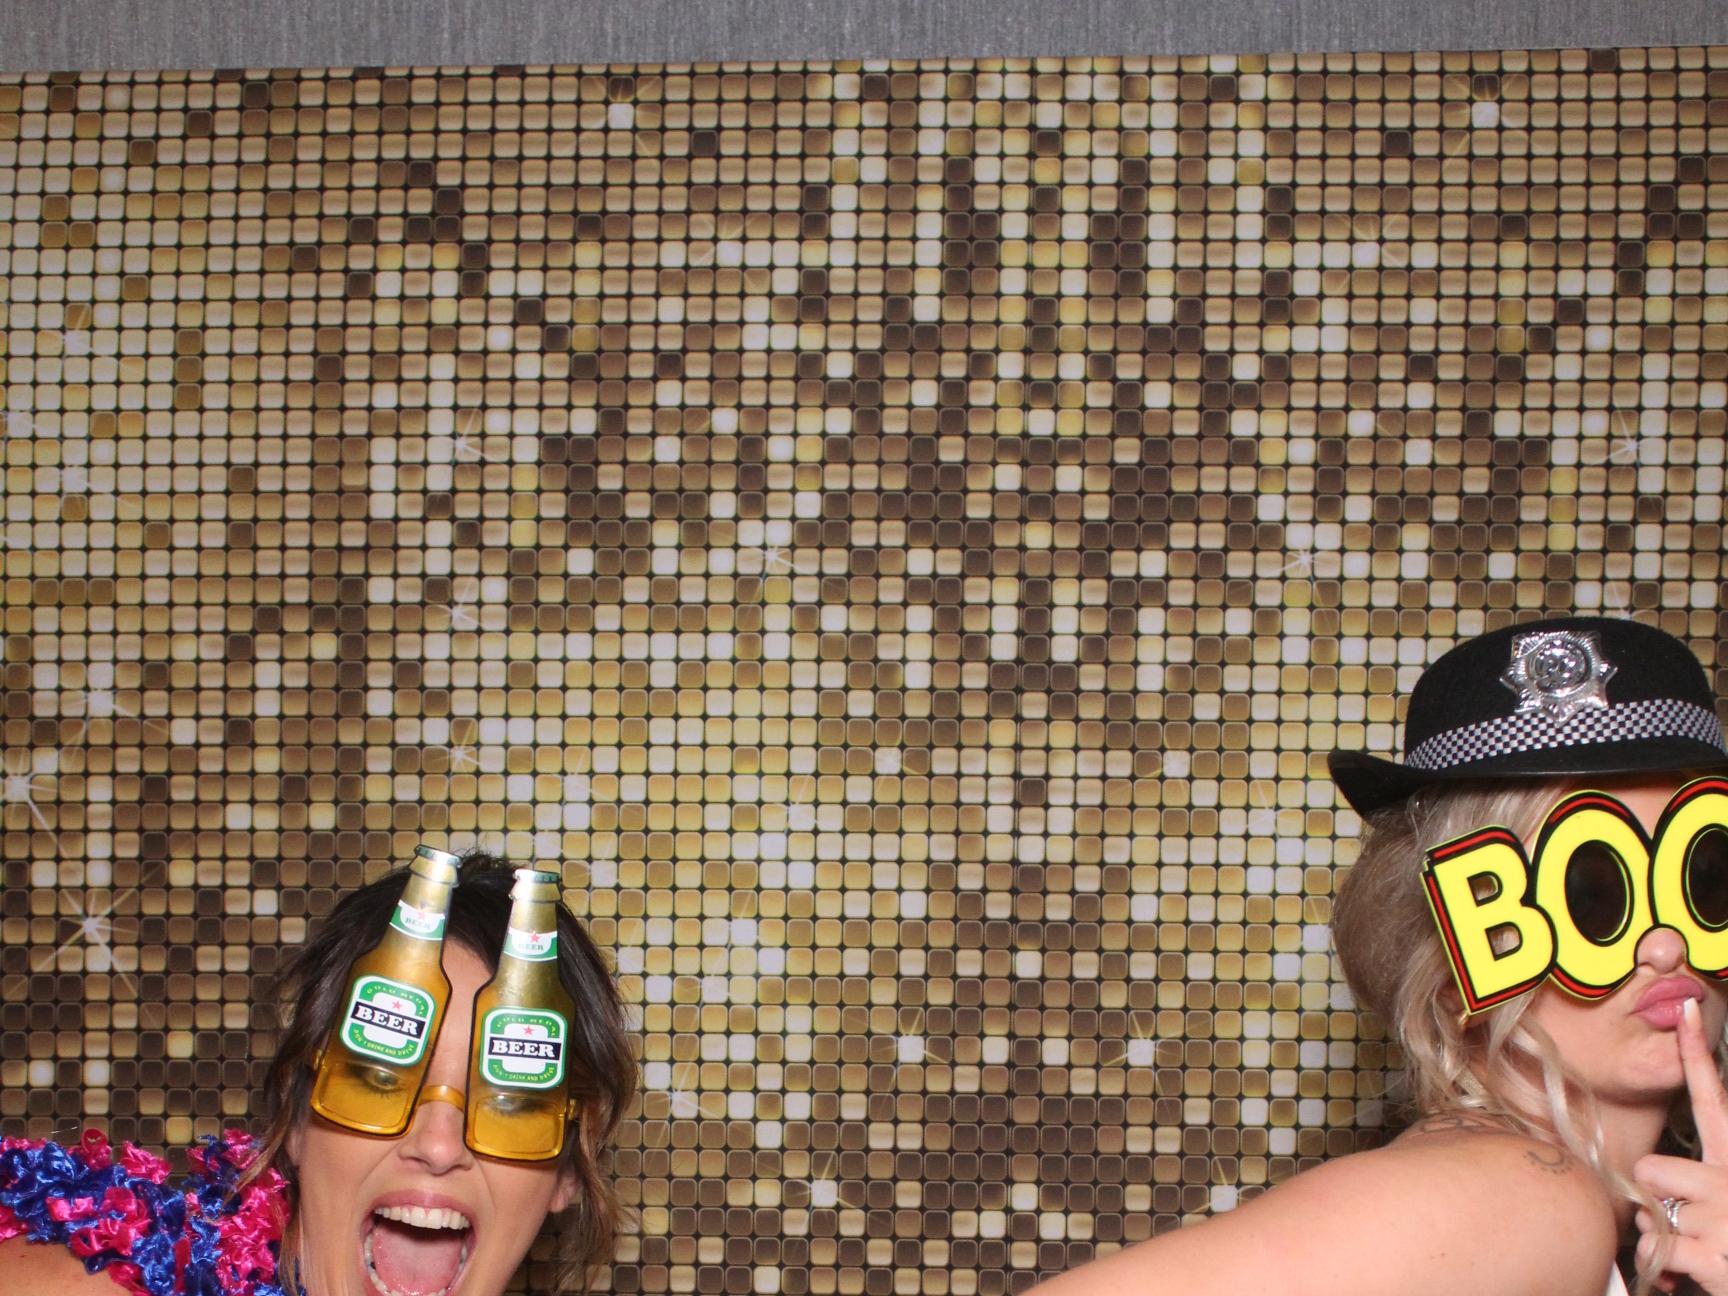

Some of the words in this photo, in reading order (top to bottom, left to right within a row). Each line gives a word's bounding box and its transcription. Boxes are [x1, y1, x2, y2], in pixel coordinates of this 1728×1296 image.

[1421, 776, 1728, 1013] BOO
[354, 1005, 418, 1036] BEER
[492, 1039, 555, 1057] BEER
